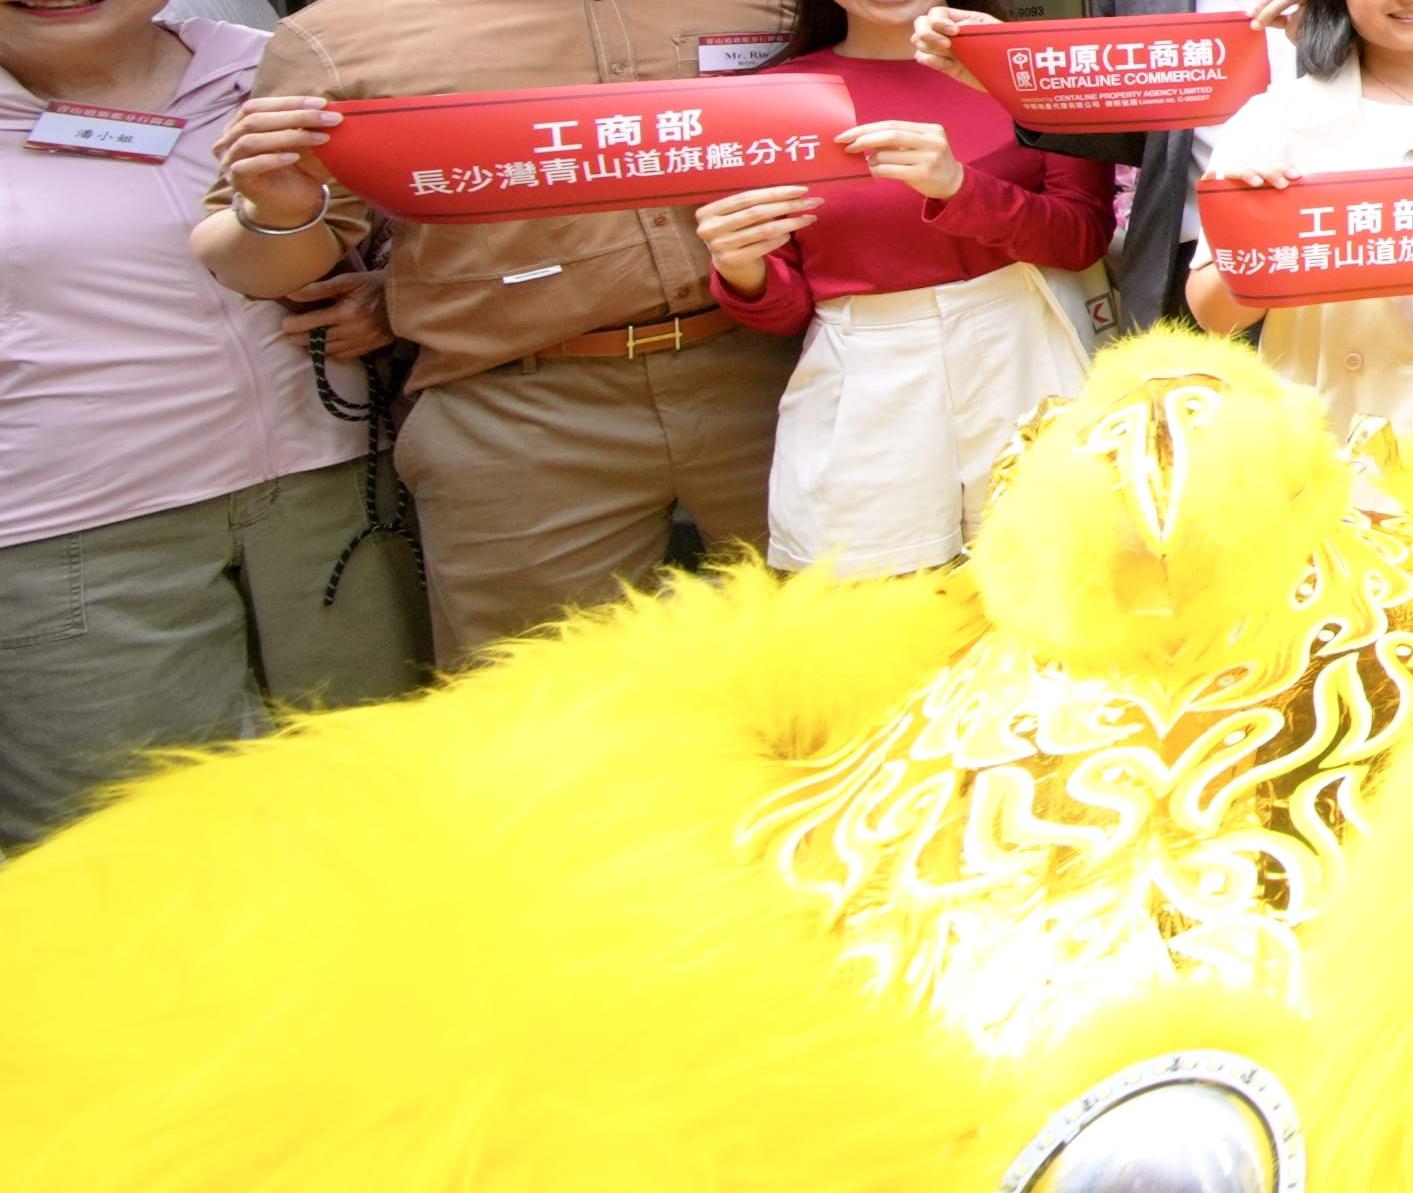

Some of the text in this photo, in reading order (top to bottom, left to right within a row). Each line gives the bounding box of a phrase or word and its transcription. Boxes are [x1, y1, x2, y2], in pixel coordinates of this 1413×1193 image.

[1039, 68, 1227, 90] CENTALINE COMMERCIAL
[1053, 92, 1097, 102] CENTALINE
[1099, 90, 1141, 100] PROPERTY
[533, 108, 703, 154] 工商部
[409, 135, 821, 196] 長沙灣青山道旗艦分行
